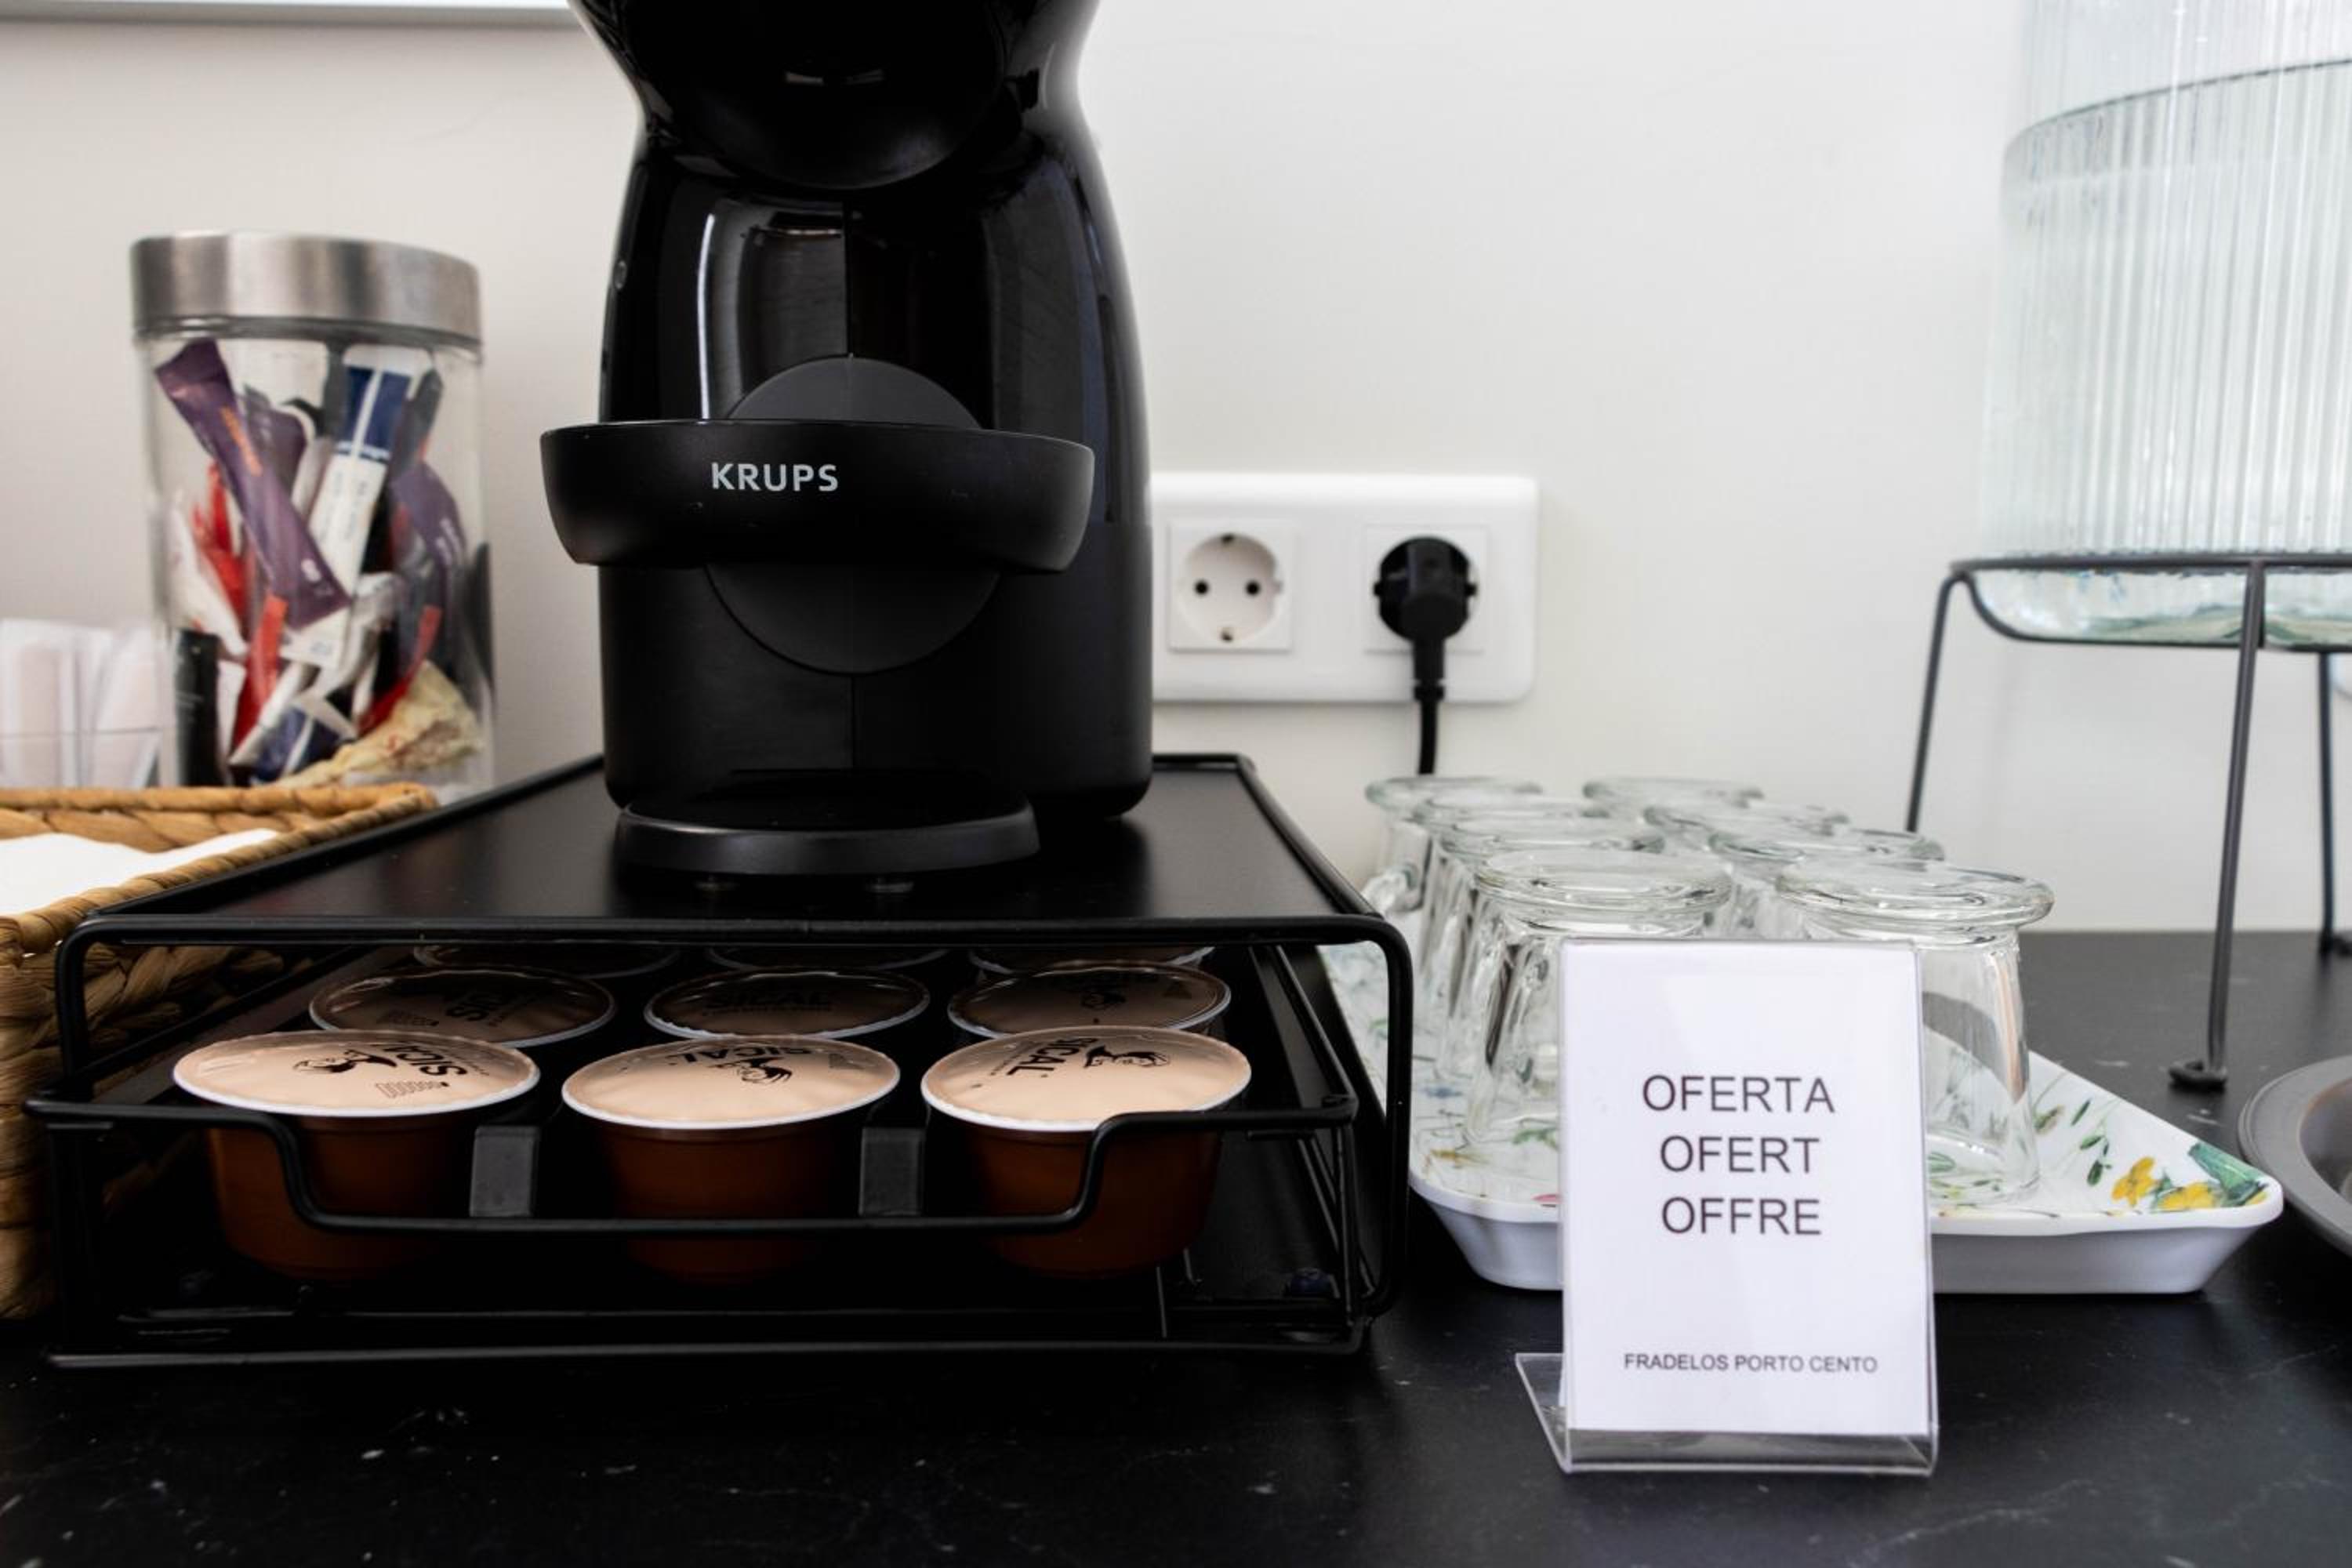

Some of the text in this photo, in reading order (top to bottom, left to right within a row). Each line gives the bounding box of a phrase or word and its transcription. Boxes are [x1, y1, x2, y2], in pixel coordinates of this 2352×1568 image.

[710, 462, 839, 492] KRUPS
[1642, 1073, 1836, 1114] OFERTA
[1659, 1134, 1820, 1174] OFERT
[1661, 1195, 1822, 1236] OFFRE
[1623, 1352, 1878, 1374] FRADELOS PORTO CENTO
